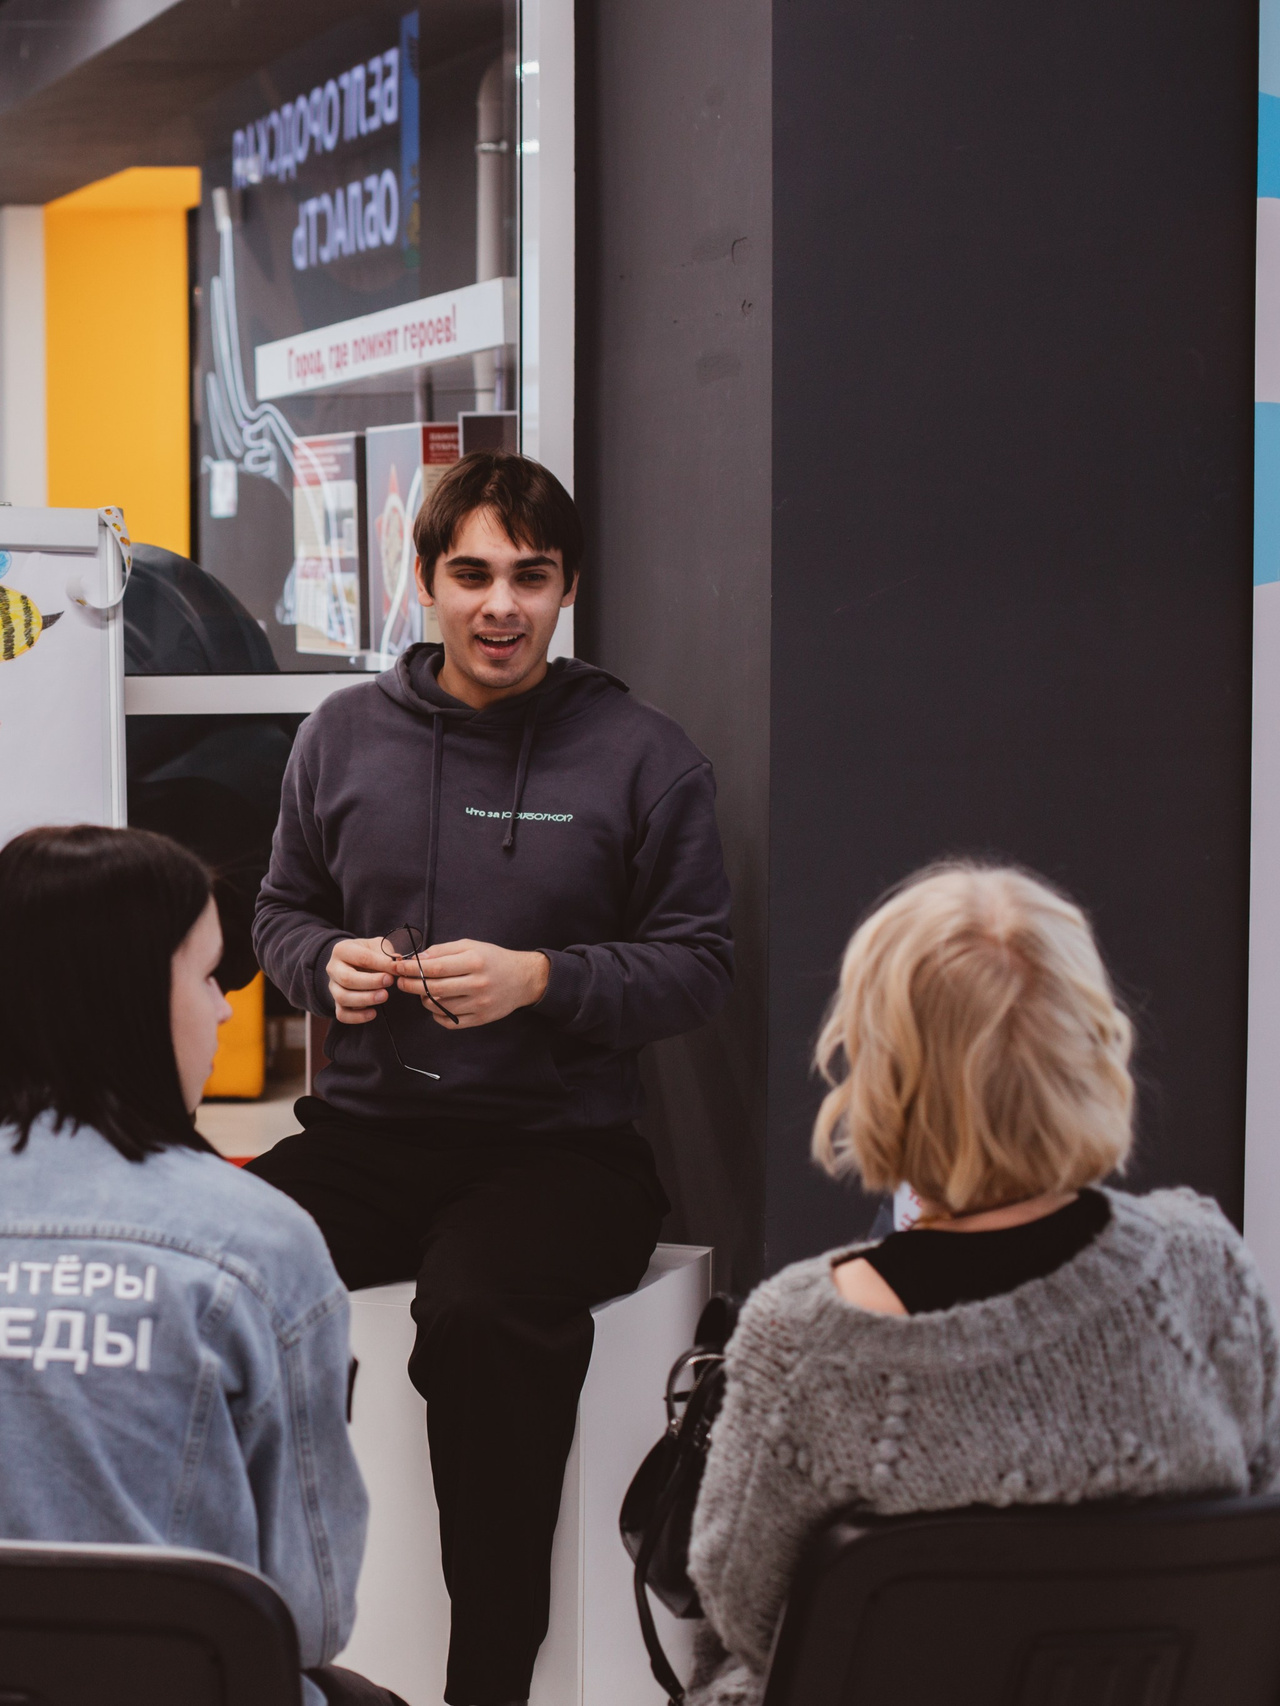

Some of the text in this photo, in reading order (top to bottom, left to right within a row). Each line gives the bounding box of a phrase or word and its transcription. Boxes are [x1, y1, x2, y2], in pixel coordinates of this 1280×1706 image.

[287, 302, 457, 388] Город, где помнят героев!
[465, 807, 486, 819] Что
[487, 811, 500, 819] за
